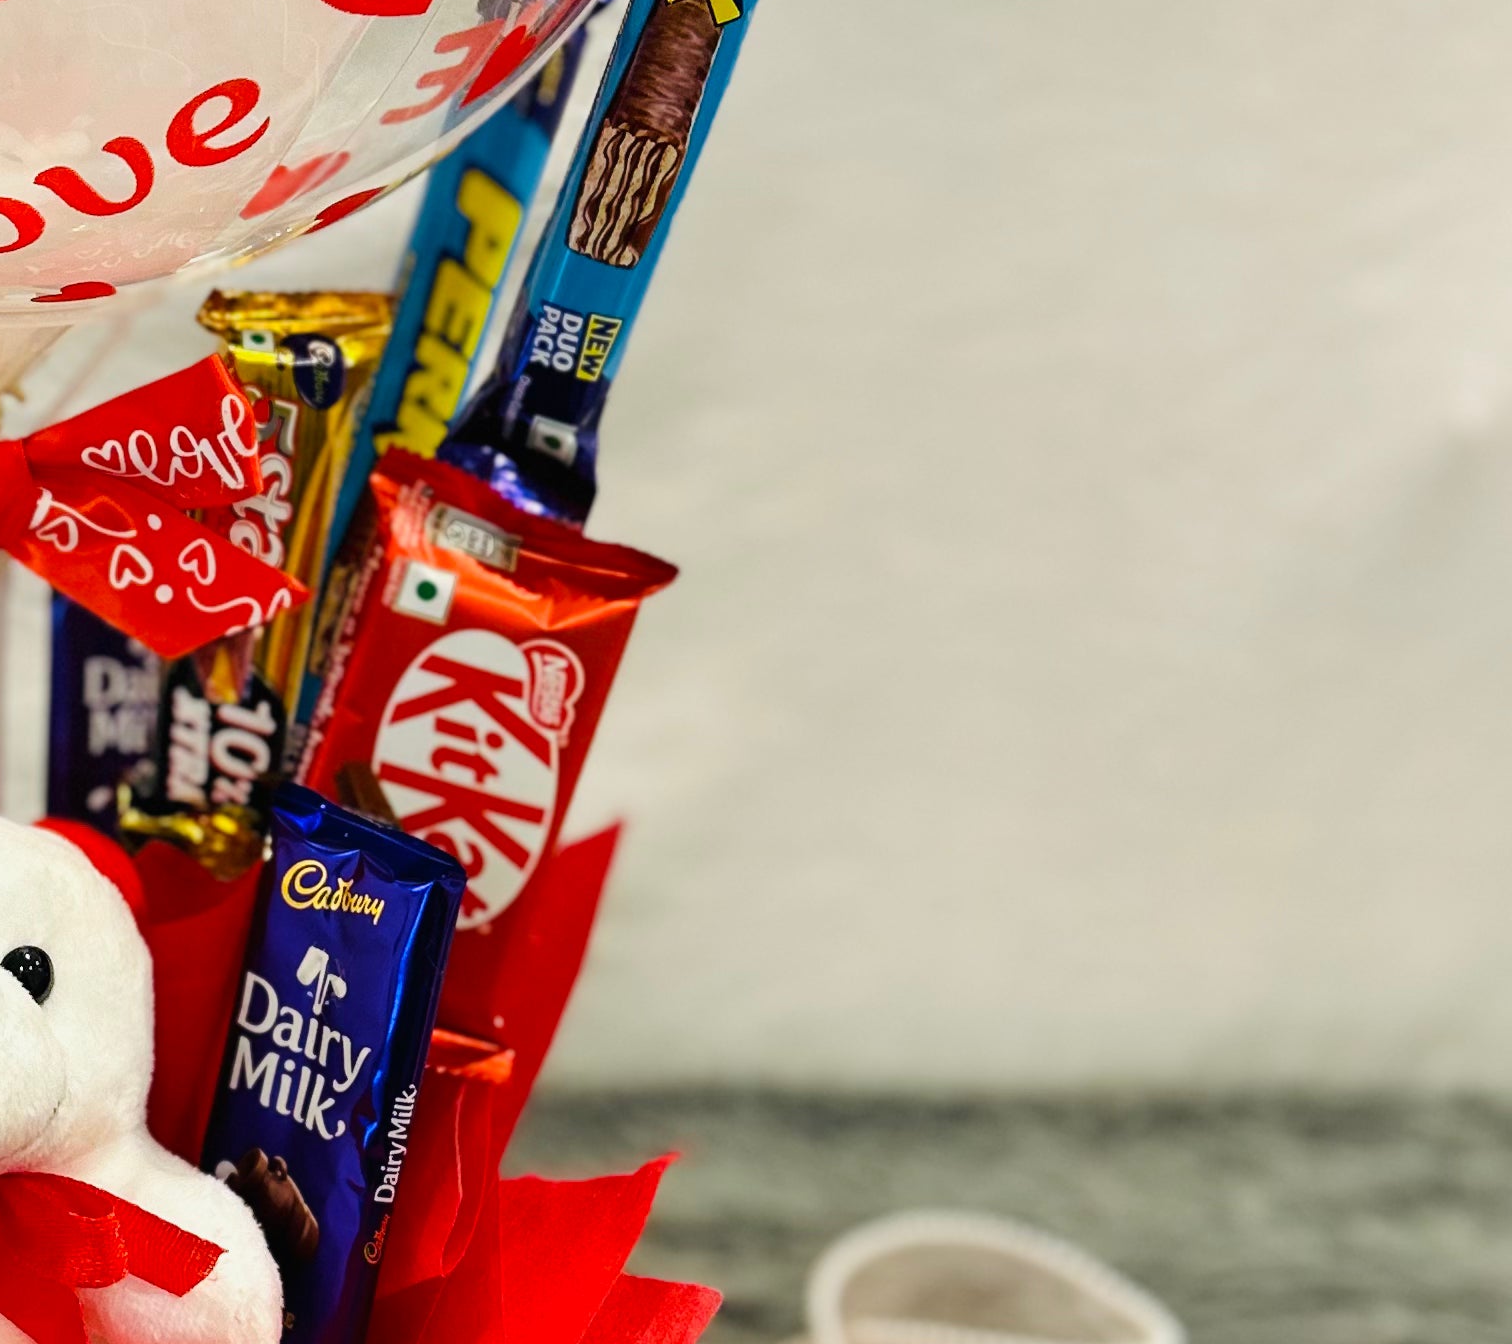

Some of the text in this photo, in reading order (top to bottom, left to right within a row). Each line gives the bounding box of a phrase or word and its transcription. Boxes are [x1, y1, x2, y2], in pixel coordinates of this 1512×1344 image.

[375, 168, 522, 460] PERK
[533, 305, 561, 367] PACK
[552, 313, 583, 372] DUO
[580, 317, 619, 380] NEW
[126, 393, 260, 490] love
[388, 654, 550, 924] KitKa
[280, 858, 386, 925] Cadbury
[236, 969, 372, 1093] Dairy
[374, 1141, 408, 1204] Dairy
